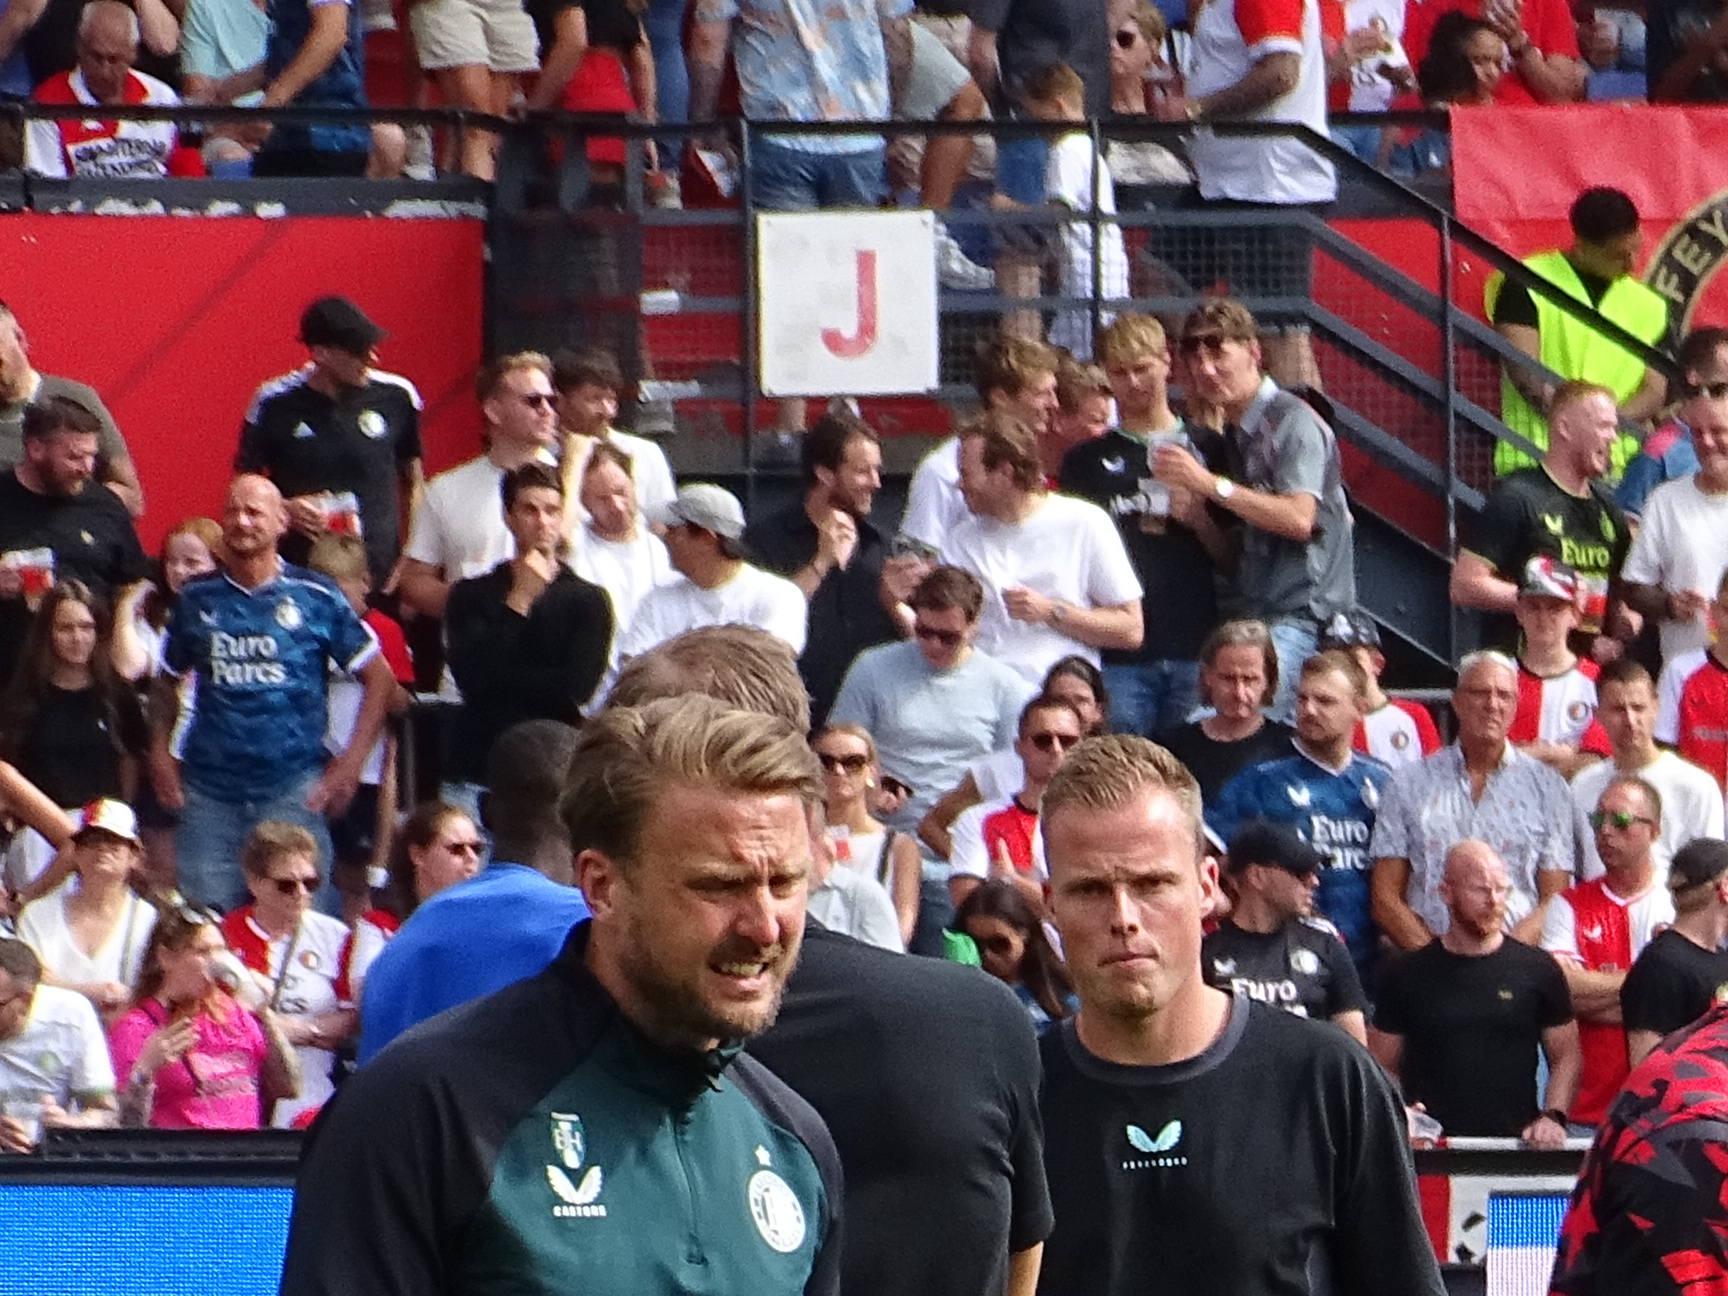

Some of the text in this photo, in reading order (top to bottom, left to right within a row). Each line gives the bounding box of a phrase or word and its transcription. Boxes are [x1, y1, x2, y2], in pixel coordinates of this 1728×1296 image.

[820, 250, 878, 360] J
[1560, 536, 1610, 568] Euro
[210, 630, 279, 659] Euro
[211, 659, 287, 687] Parcs
[1310, 813, 1370, 843] Euro
